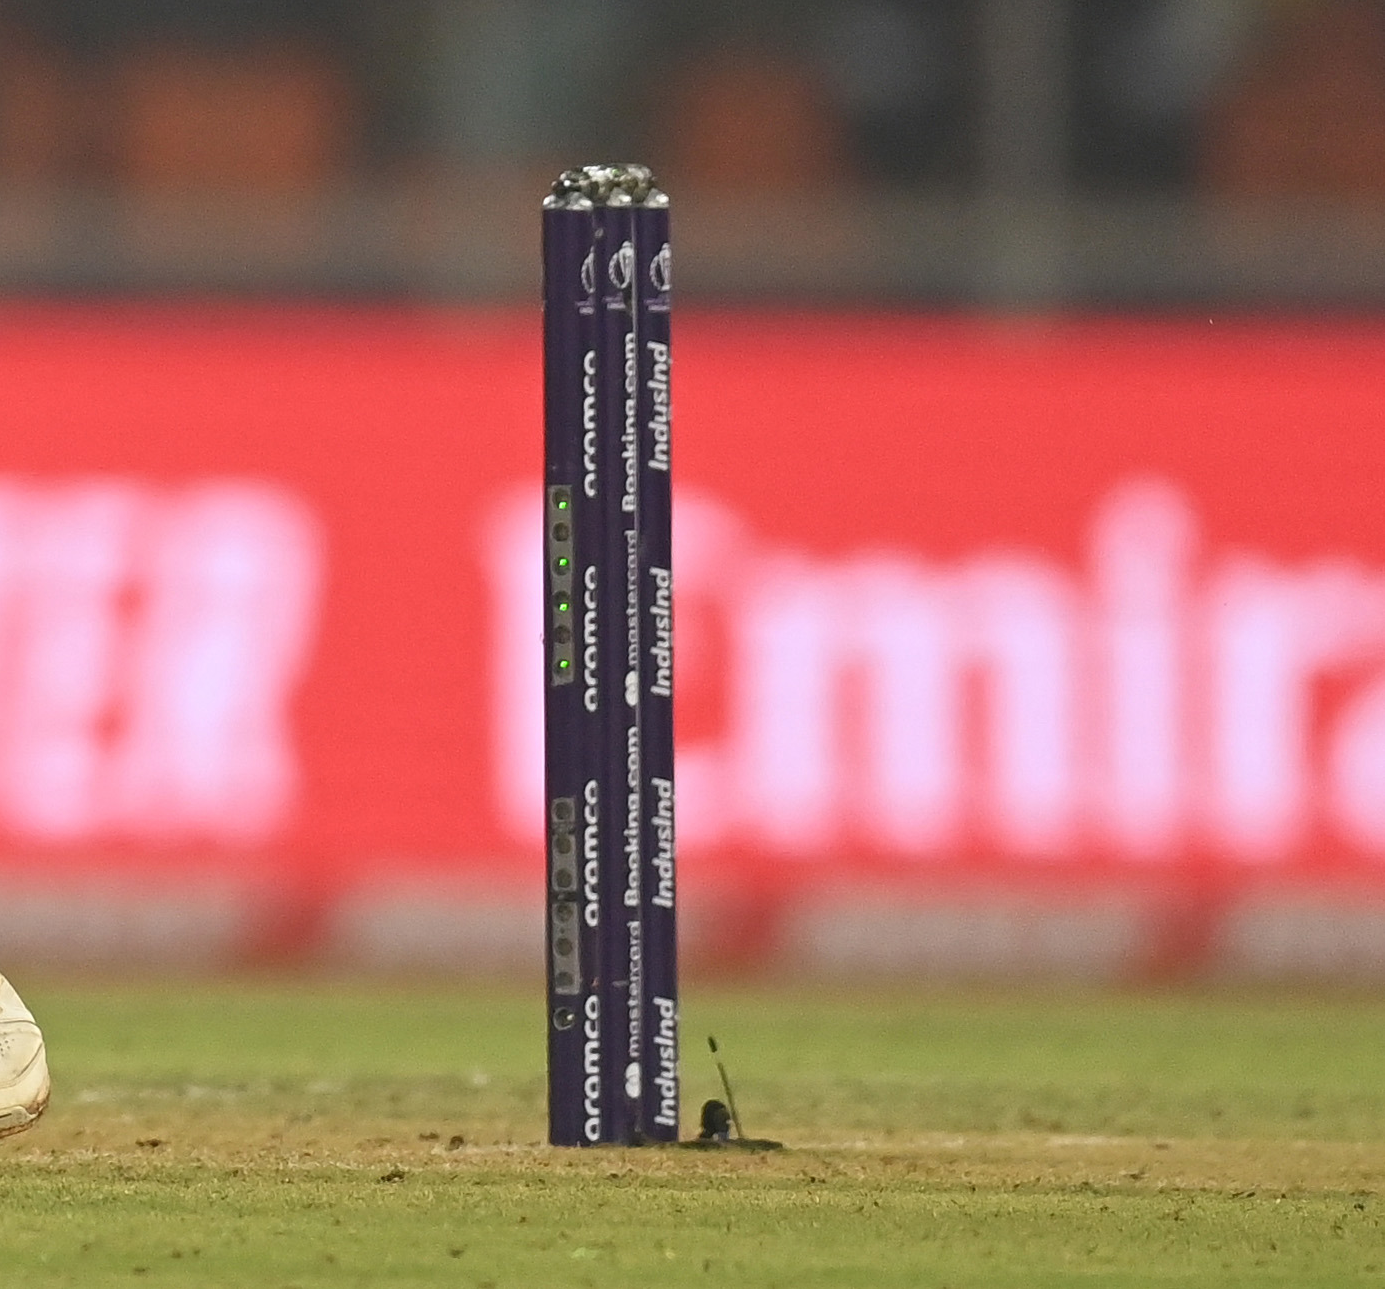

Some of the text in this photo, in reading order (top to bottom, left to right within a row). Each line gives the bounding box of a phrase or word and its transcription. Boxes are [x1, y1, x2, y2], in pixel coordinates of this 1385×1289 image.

[647, 340, 671, 471] IndusInd
[584, 565, 598, 712] aramco
[649, 566, 672, 697] IndusInd
[584, 779, 599, 927] aramco
[651, 777, 674, 908] IndusInd
[584, 995, 600, 1142] aramco
[653, 996, 676, 1126] IndusInd
